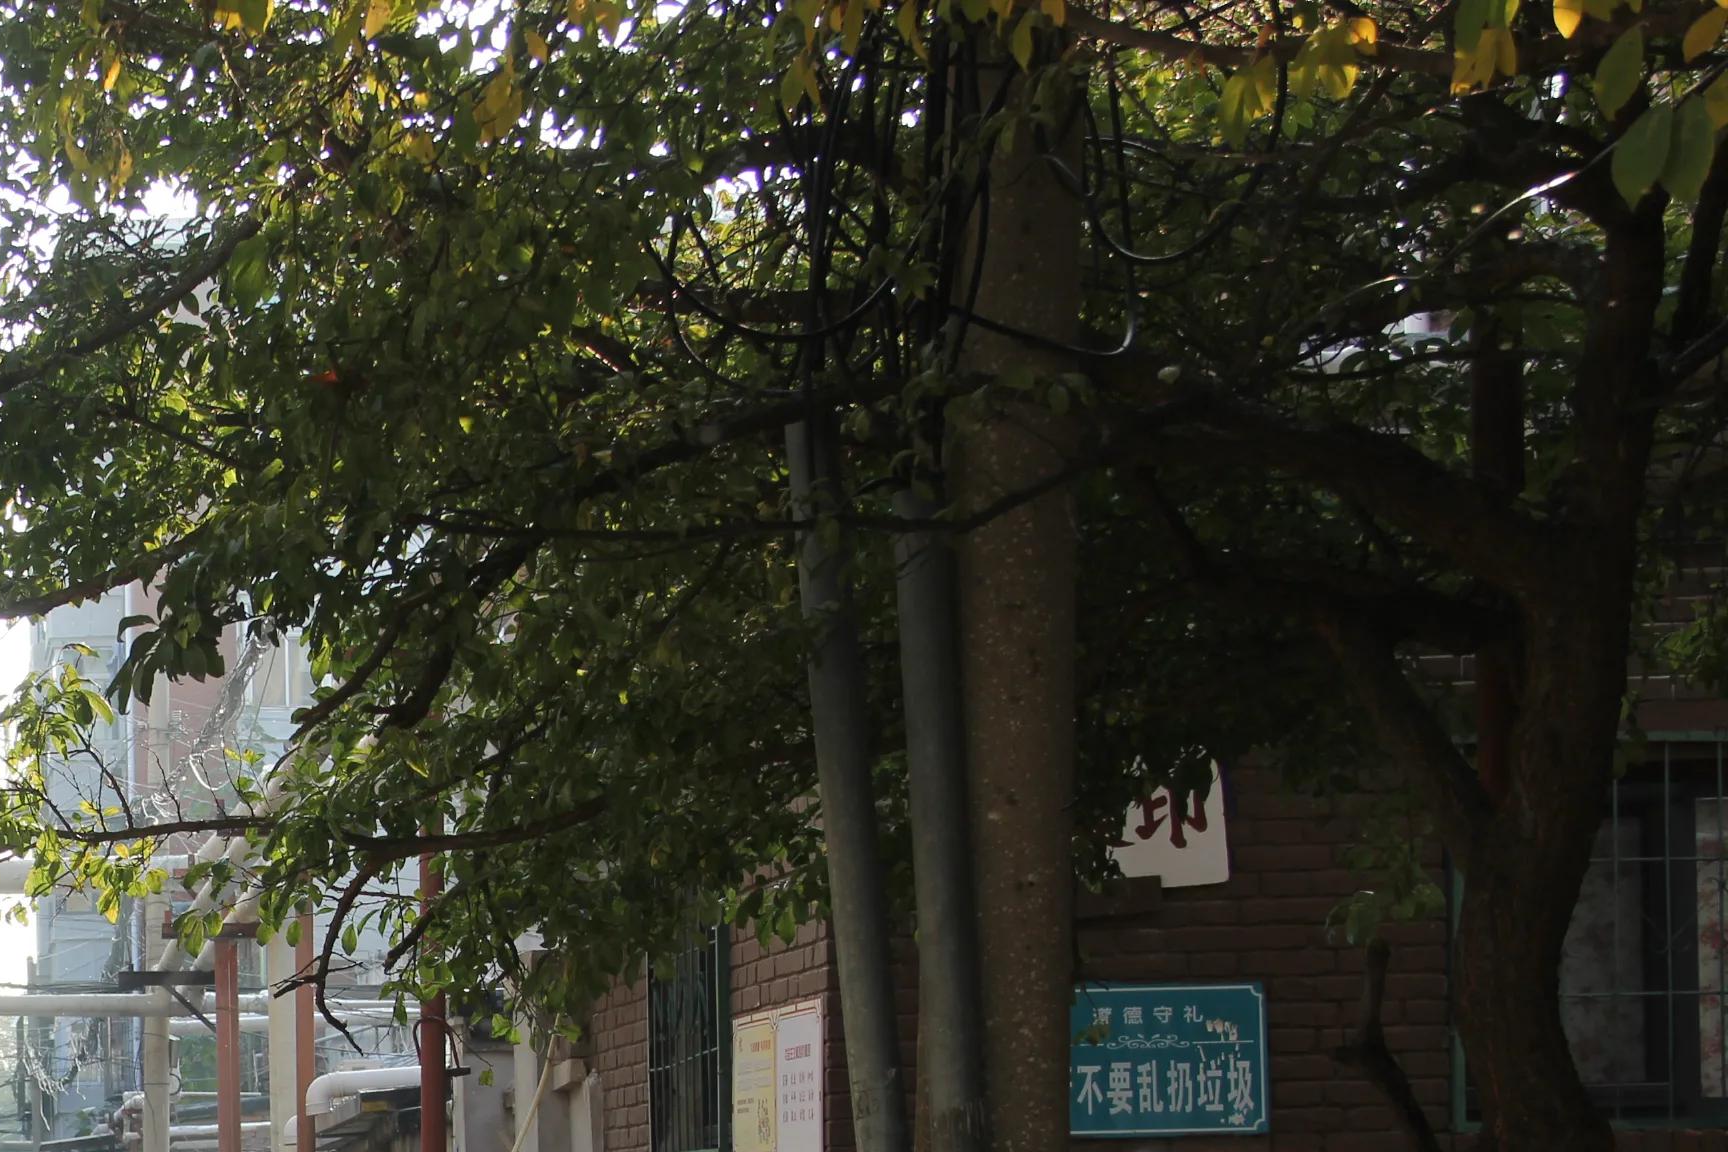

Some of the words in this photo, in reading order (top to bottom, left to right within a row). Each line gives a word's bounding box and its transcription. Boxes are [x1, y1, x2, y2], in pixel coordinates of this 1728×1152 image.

[1091, 1005, 1204, 1025] 遵德守礼
[1070, 1058, 1255, 1116] 不要乱扔垃圾
